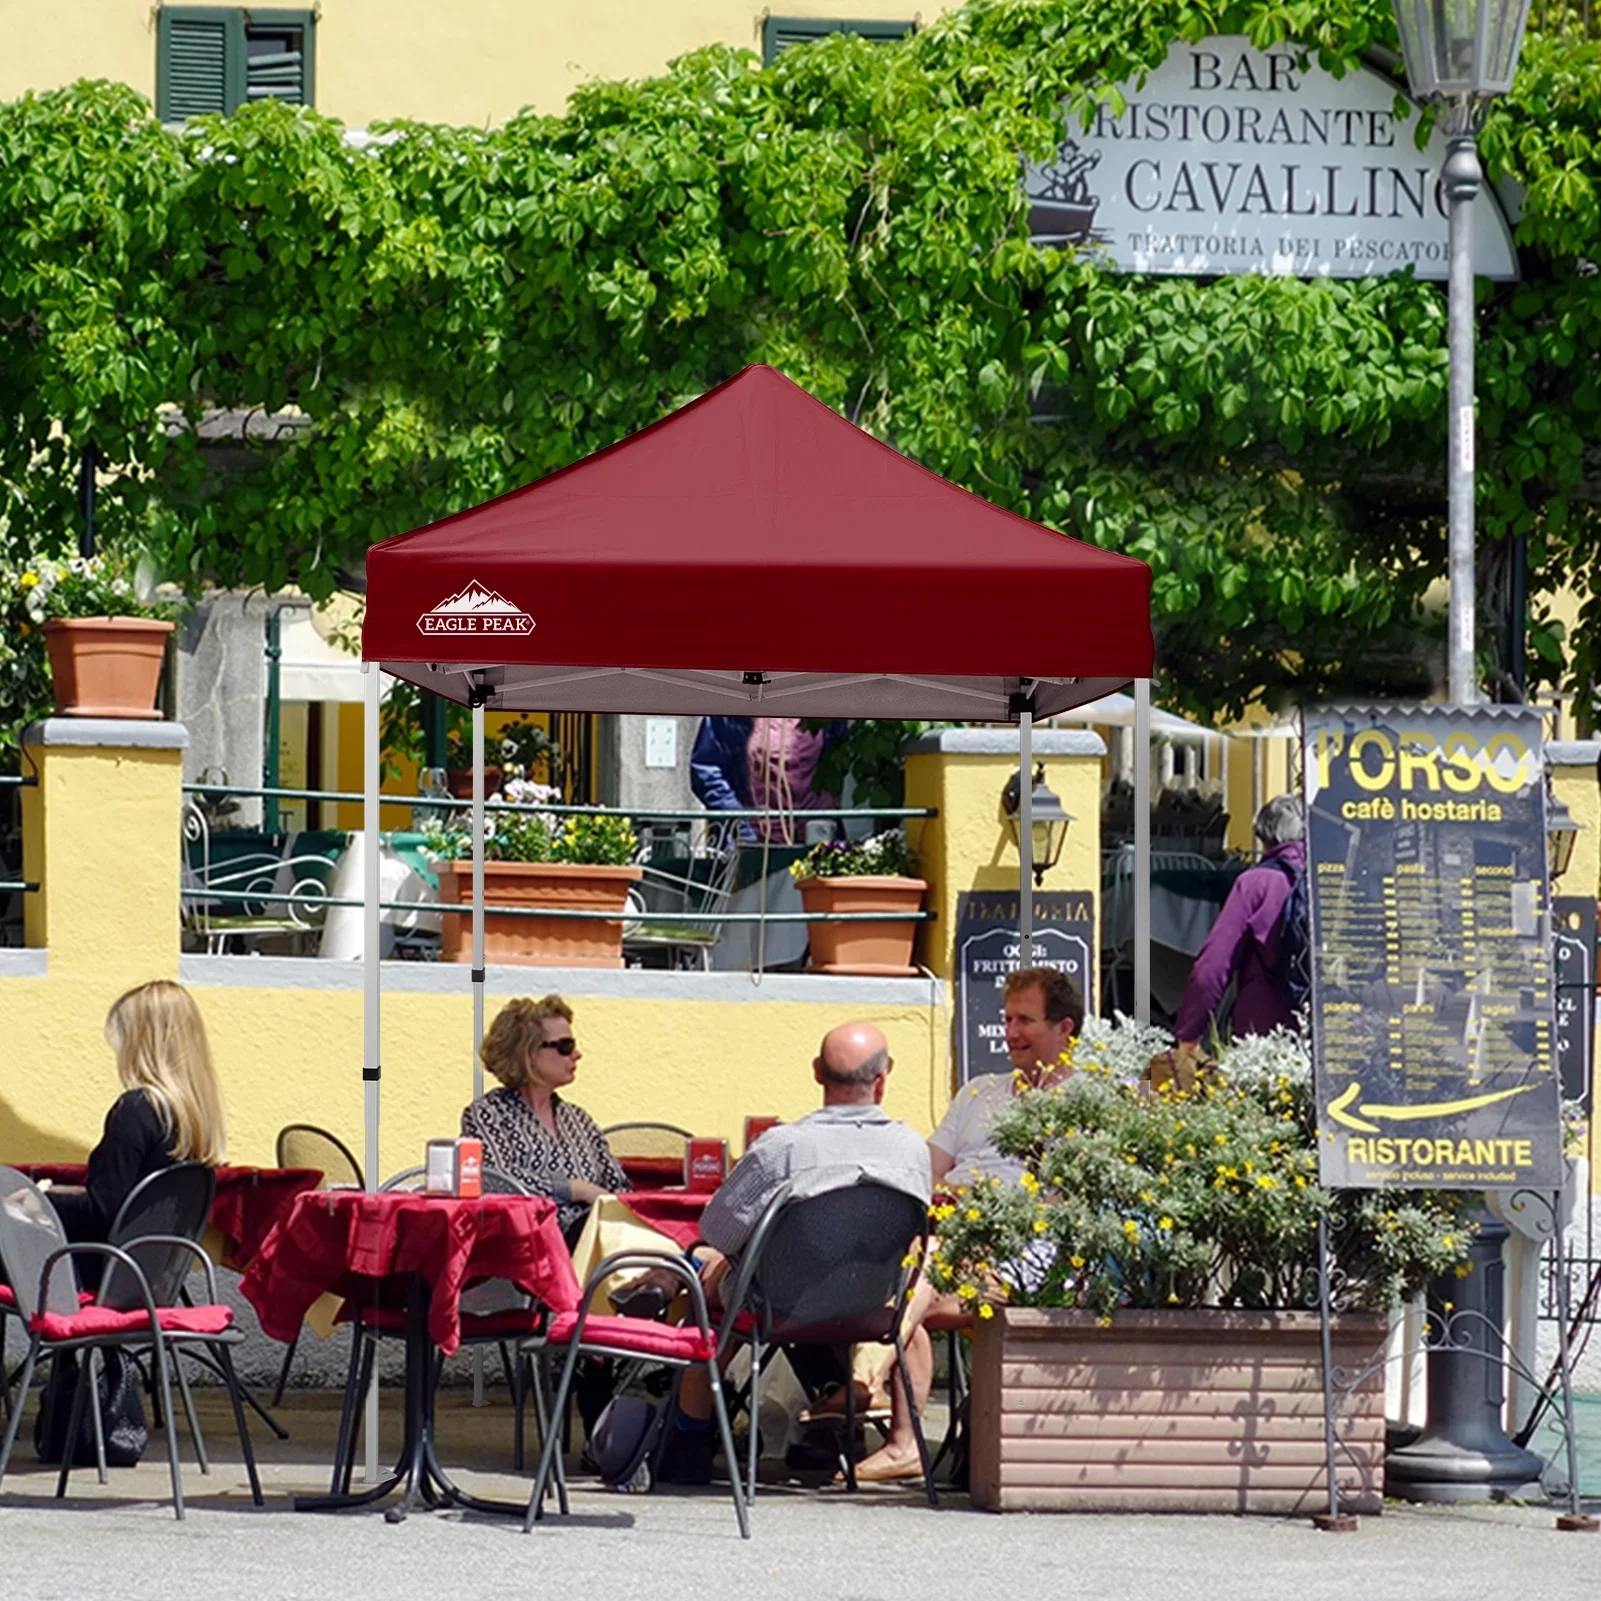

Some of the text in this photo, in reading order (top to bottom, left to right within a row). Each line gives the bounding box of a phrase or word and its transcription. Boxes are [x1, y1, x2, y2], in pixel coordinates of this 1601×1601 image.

[1188, 52, 1301, 92] BAR
[1093, 102, 1395, 148] RISTORANTE
[1128, 232, 1264, 256] TRATTORIA
[1278, 237, 1321, 258] DEI
[424, 617, 528, 631] EAGLE PEAK
[1401, 799, 1501, 821] hostaria
[1347, 1138, 1533, 1167] RISTORANTE
